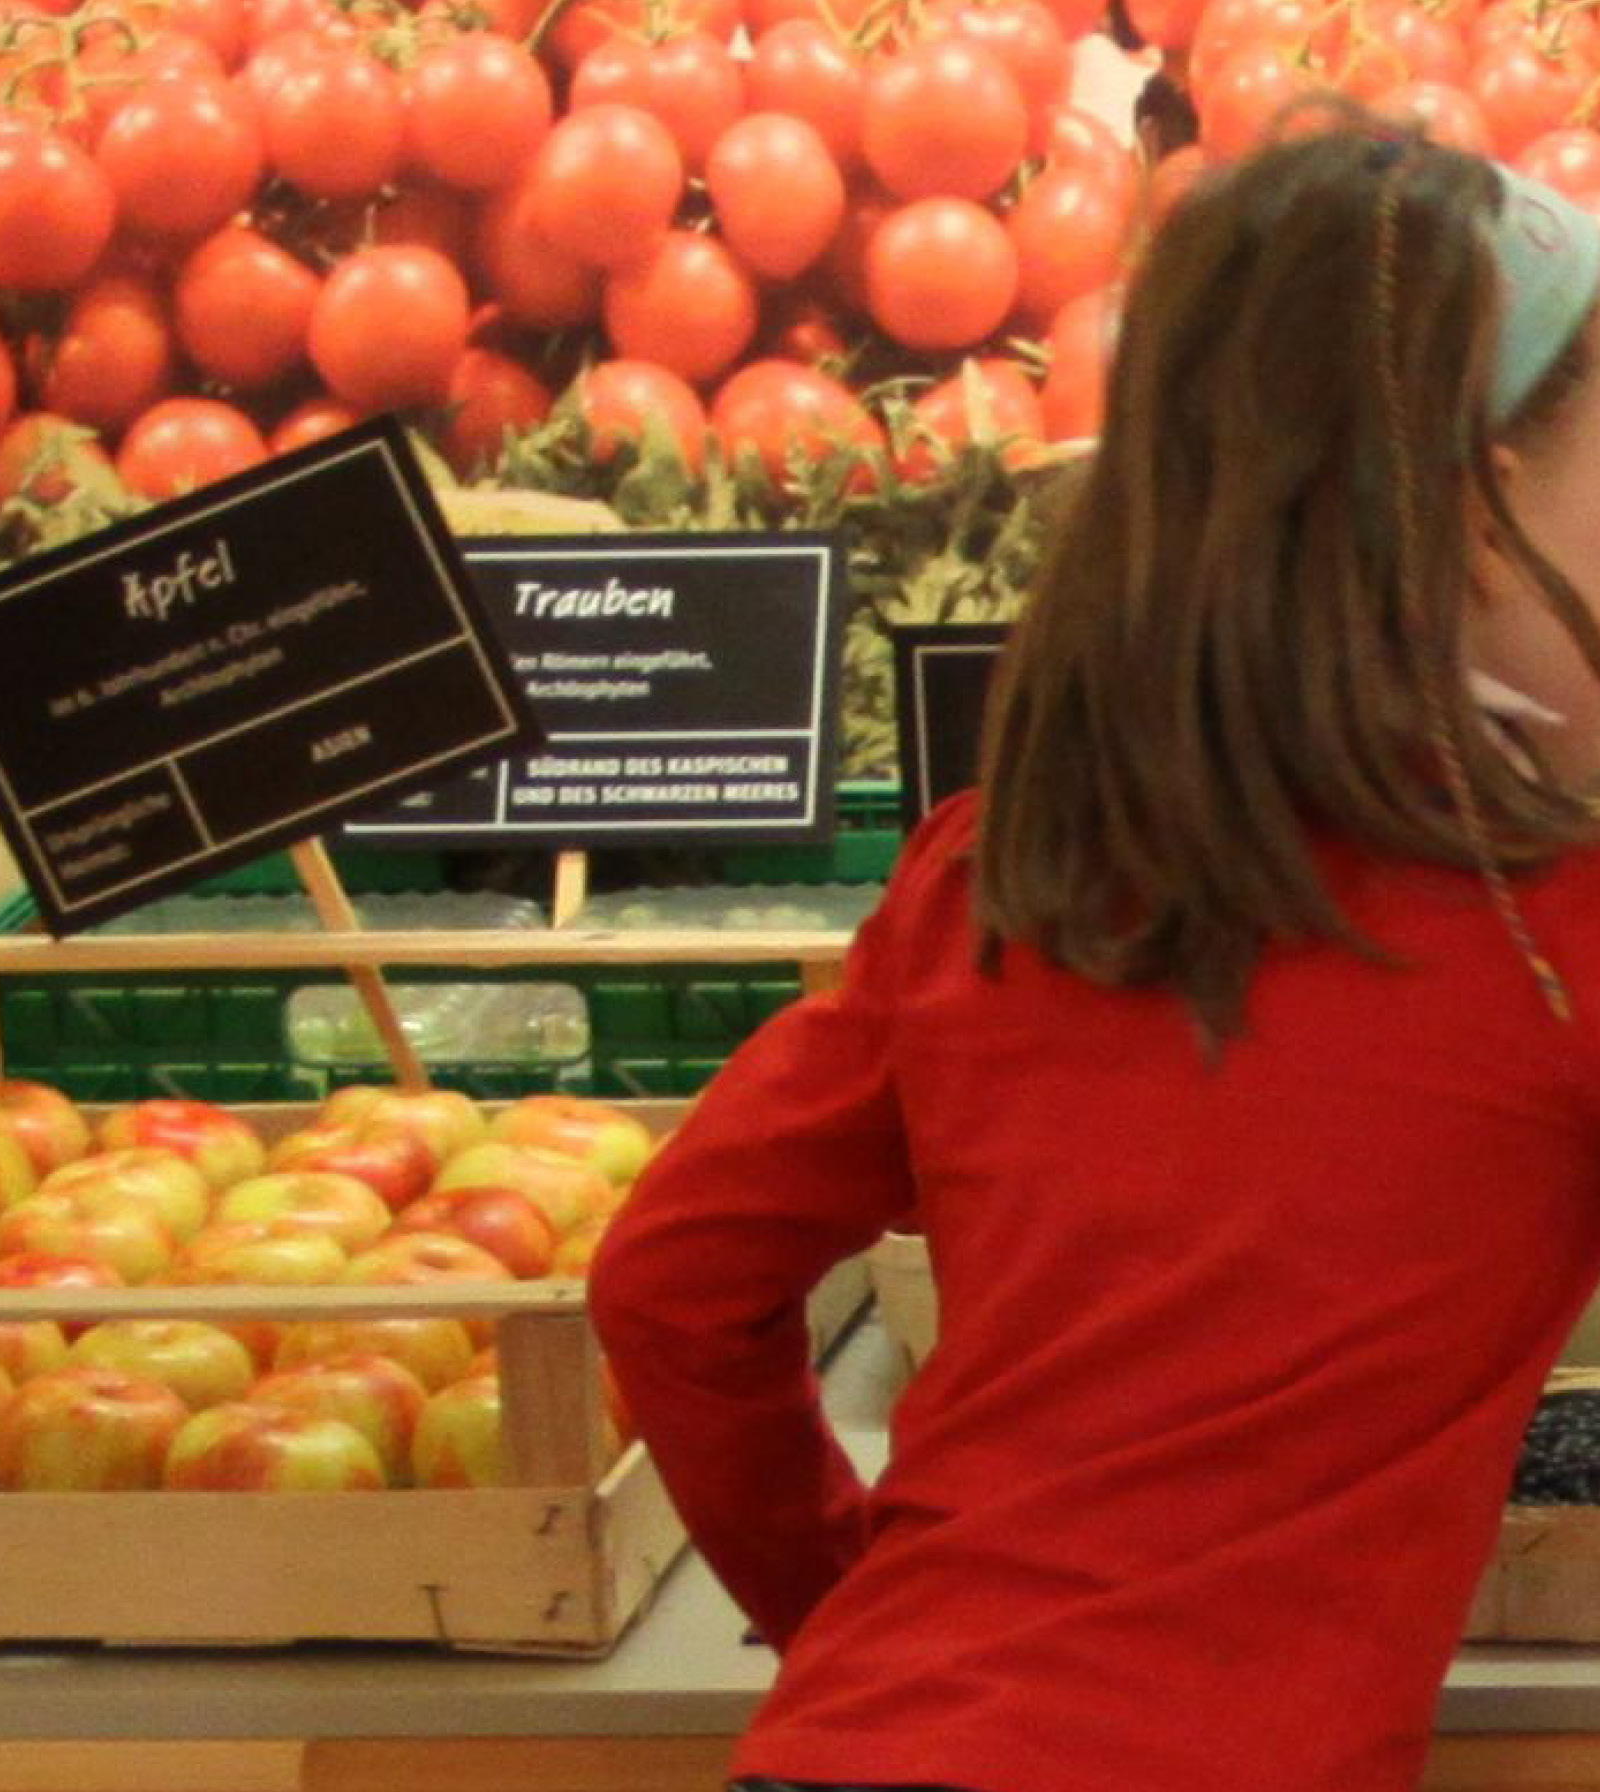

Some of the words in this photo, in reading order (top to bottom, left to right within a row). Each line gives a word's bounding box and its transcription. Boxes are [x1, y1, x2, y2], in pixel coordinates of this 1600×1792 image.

[122, 540, 236, 621] Äpfel
[514, 577, 675, 619] Trauben
[310, 725, 373, 763] ASIEN
[527, 754, 619, 779] SÜDRAND
[624, 756, 663, 777] DES
[667, 754, 789, 776] KASPISCHEN
[511, 783, 555, 806] UND
[558, 783, 598, 804] DES
[601, 781, 719, 804] SCHWARZEN
[723, 780, 800, 802] MEERES
